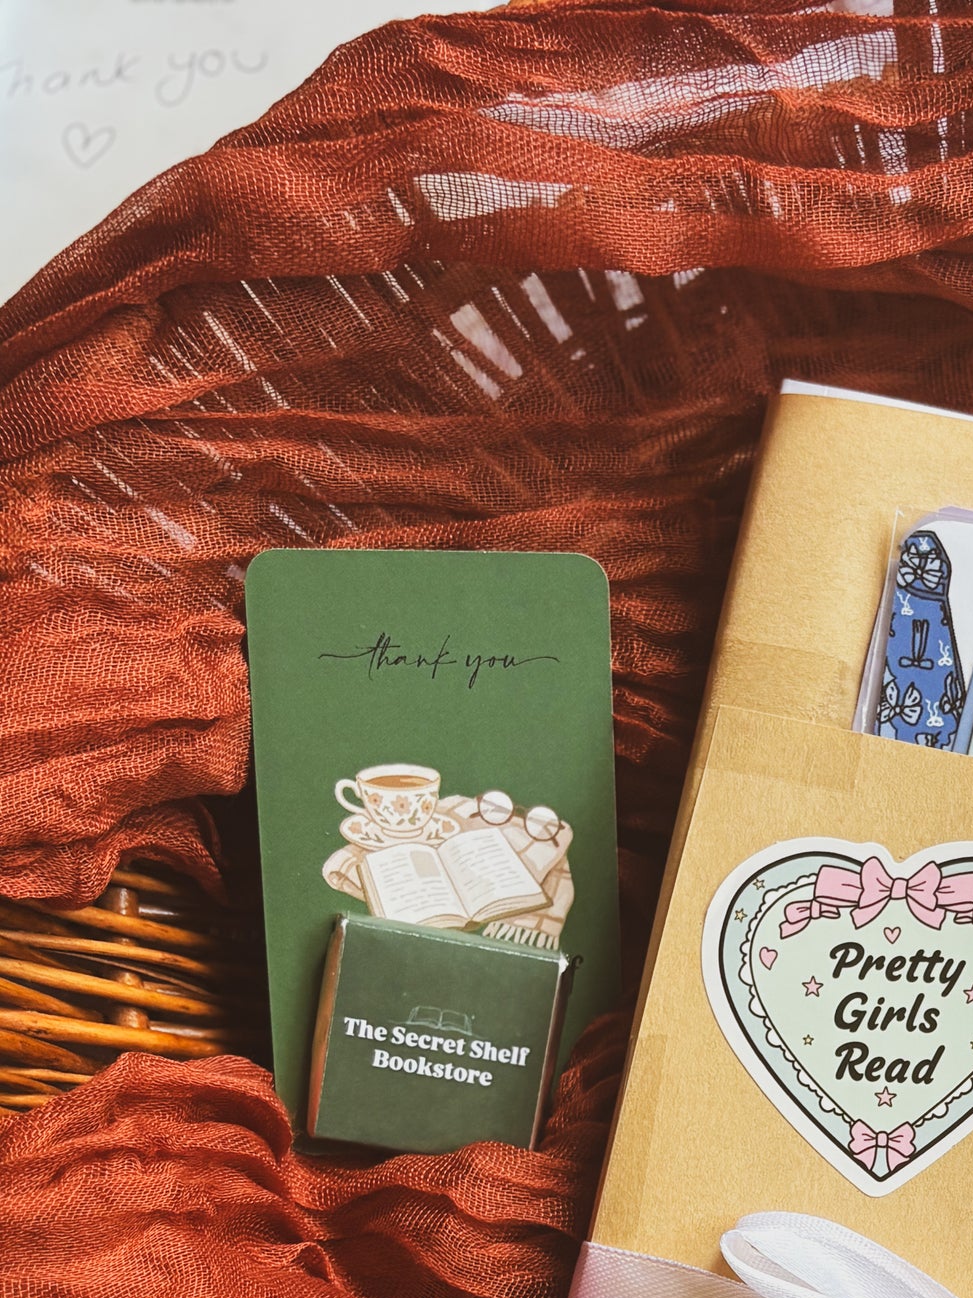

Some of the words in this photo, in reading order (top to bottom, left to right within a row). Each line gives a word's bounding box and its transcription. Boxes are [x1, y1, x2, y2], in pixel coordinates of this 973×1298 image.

[154, 49, 269, 108] you
[318, 632, 457, 681] thank
[465, 653, 560, 689] you
[829, 941, 967, 998] Pretty
[833, 991, 940, 1034] Girls
[343, 1016, 388, 1042] The
[391, 1025, 466, 1056] Secret
[468, 1039, 531, 1067] Shelf
[834, 1041, 946, 1085] Read
[371, 1048, 493, 1087] Bookstore
